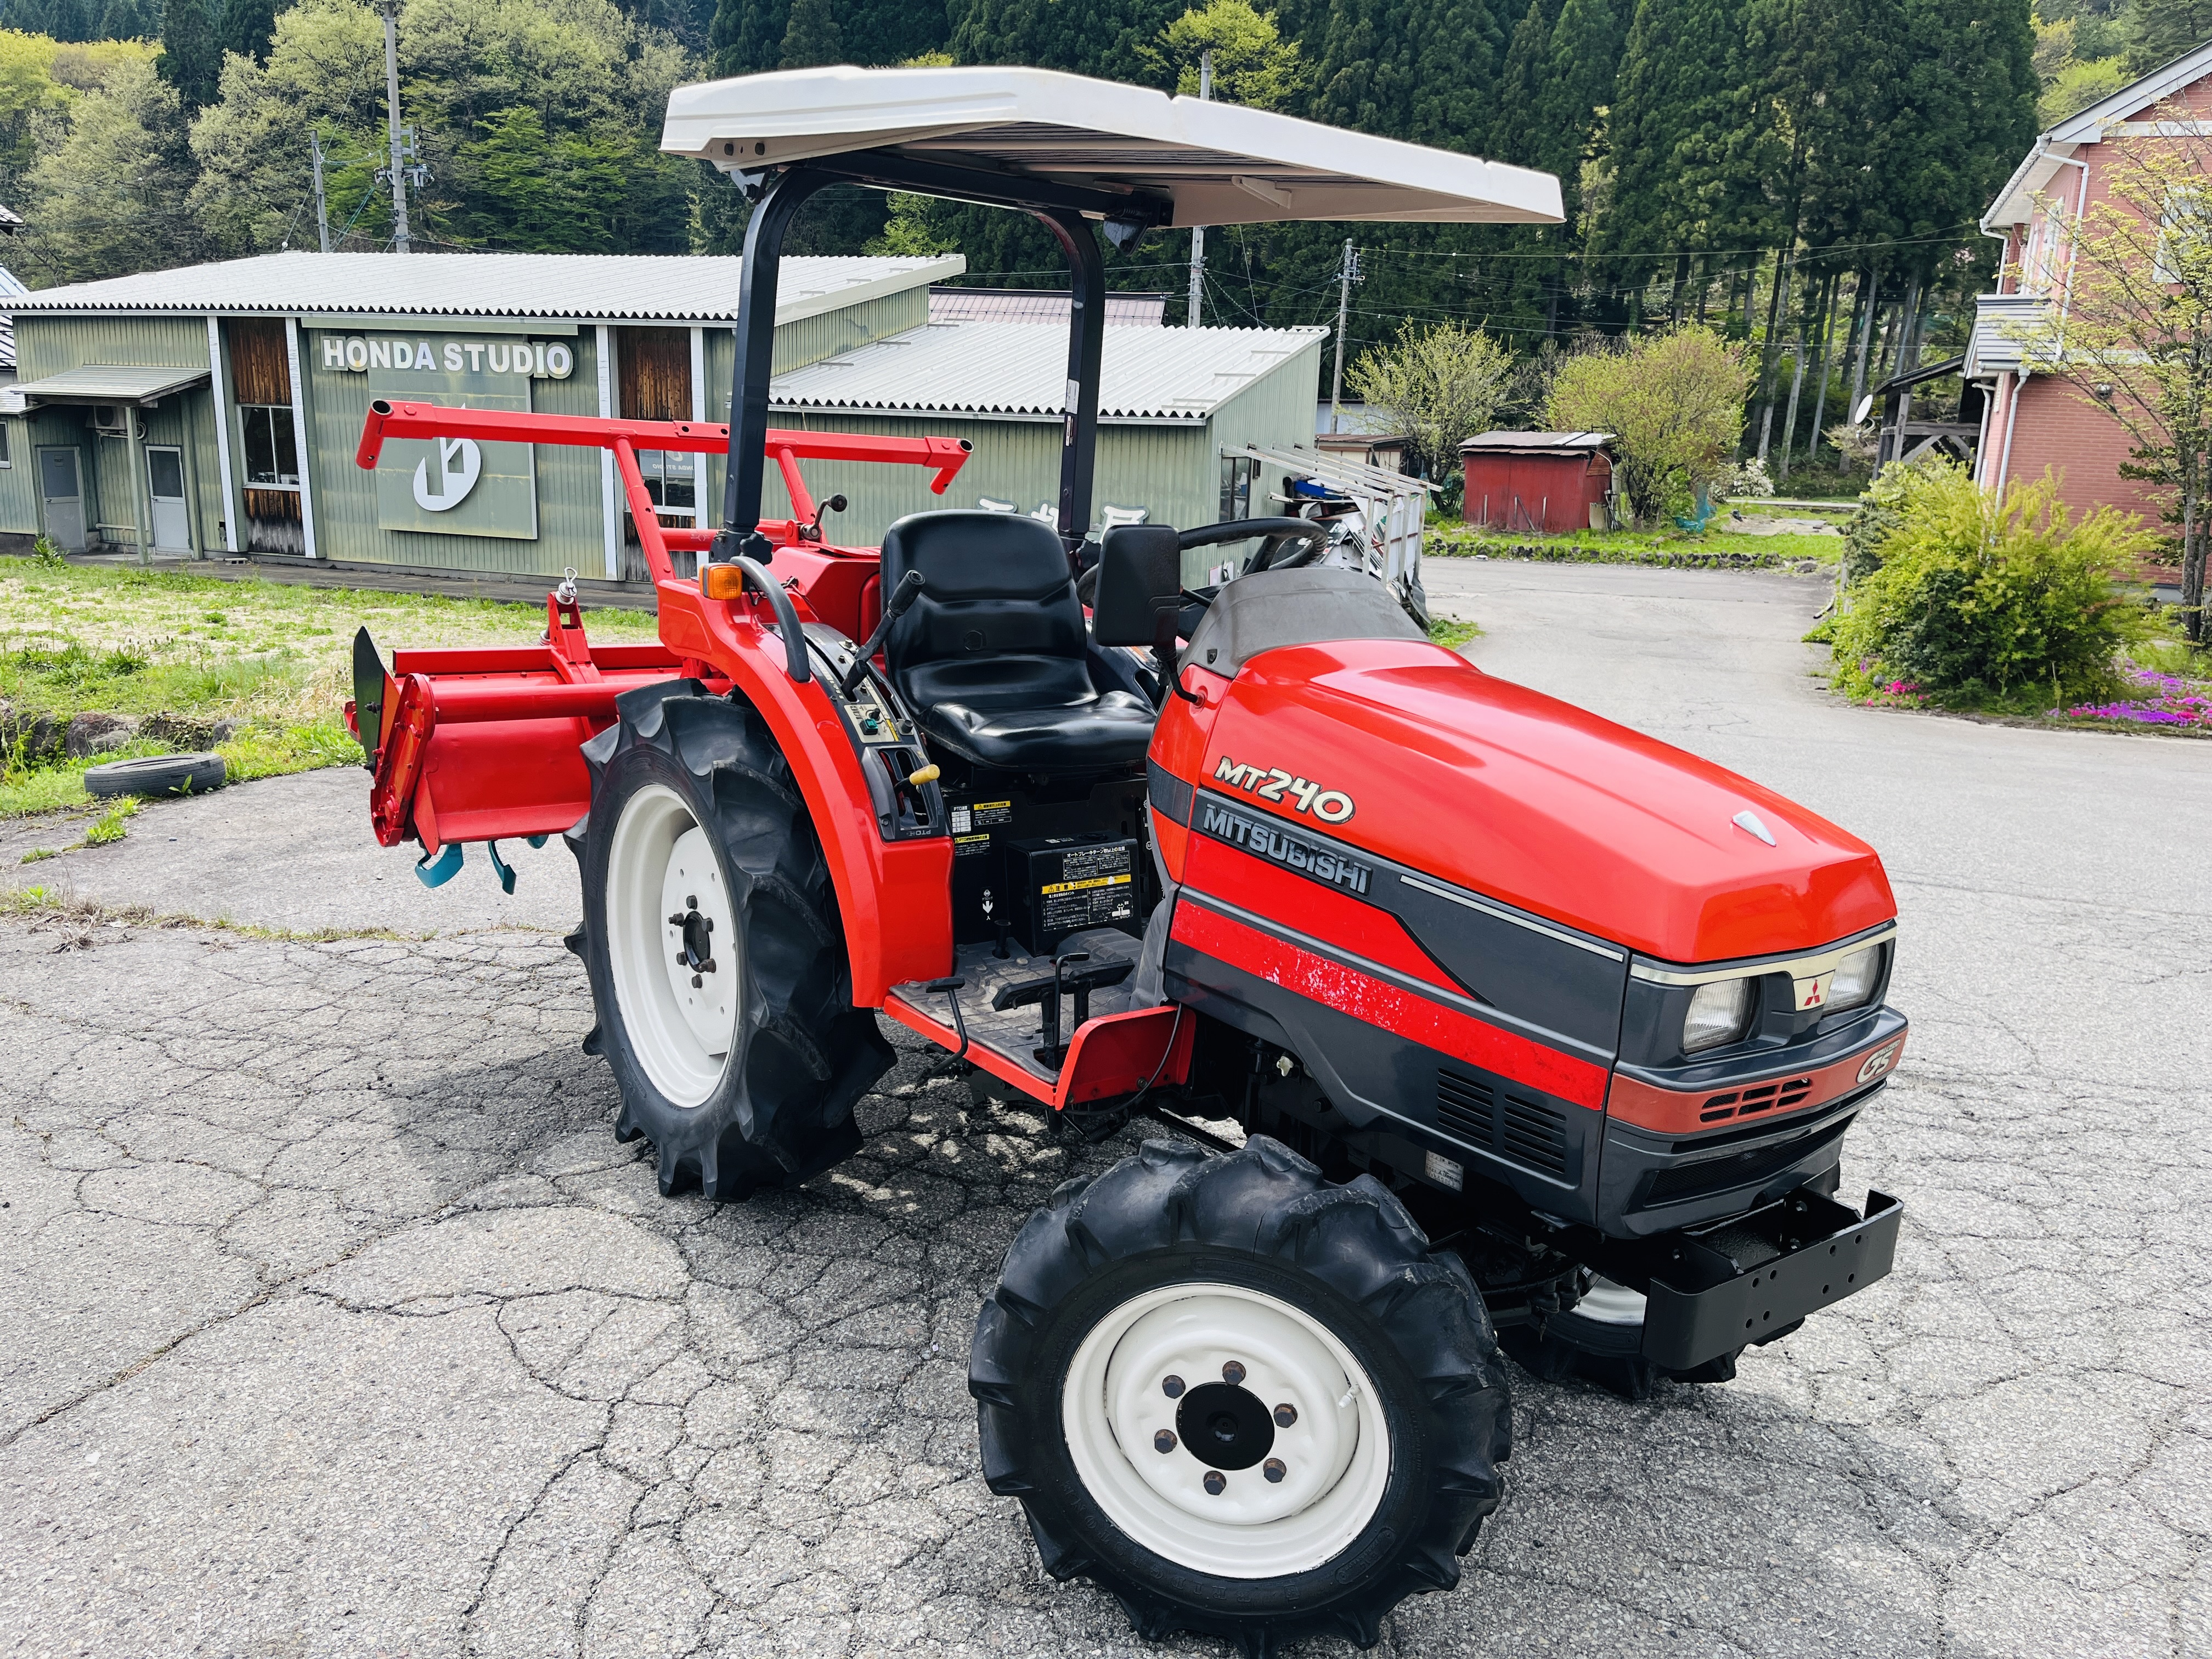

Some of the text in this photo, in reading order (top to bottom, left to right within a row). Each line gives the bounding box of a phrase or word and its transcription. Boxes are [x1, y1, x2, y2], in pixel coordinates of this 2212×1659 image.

[323, 338, 570, 375] HONDA STUDIO
[1214, 755, 1356, 825] MT240
[1203, 804, 1373, 896] MITSUBISHI
